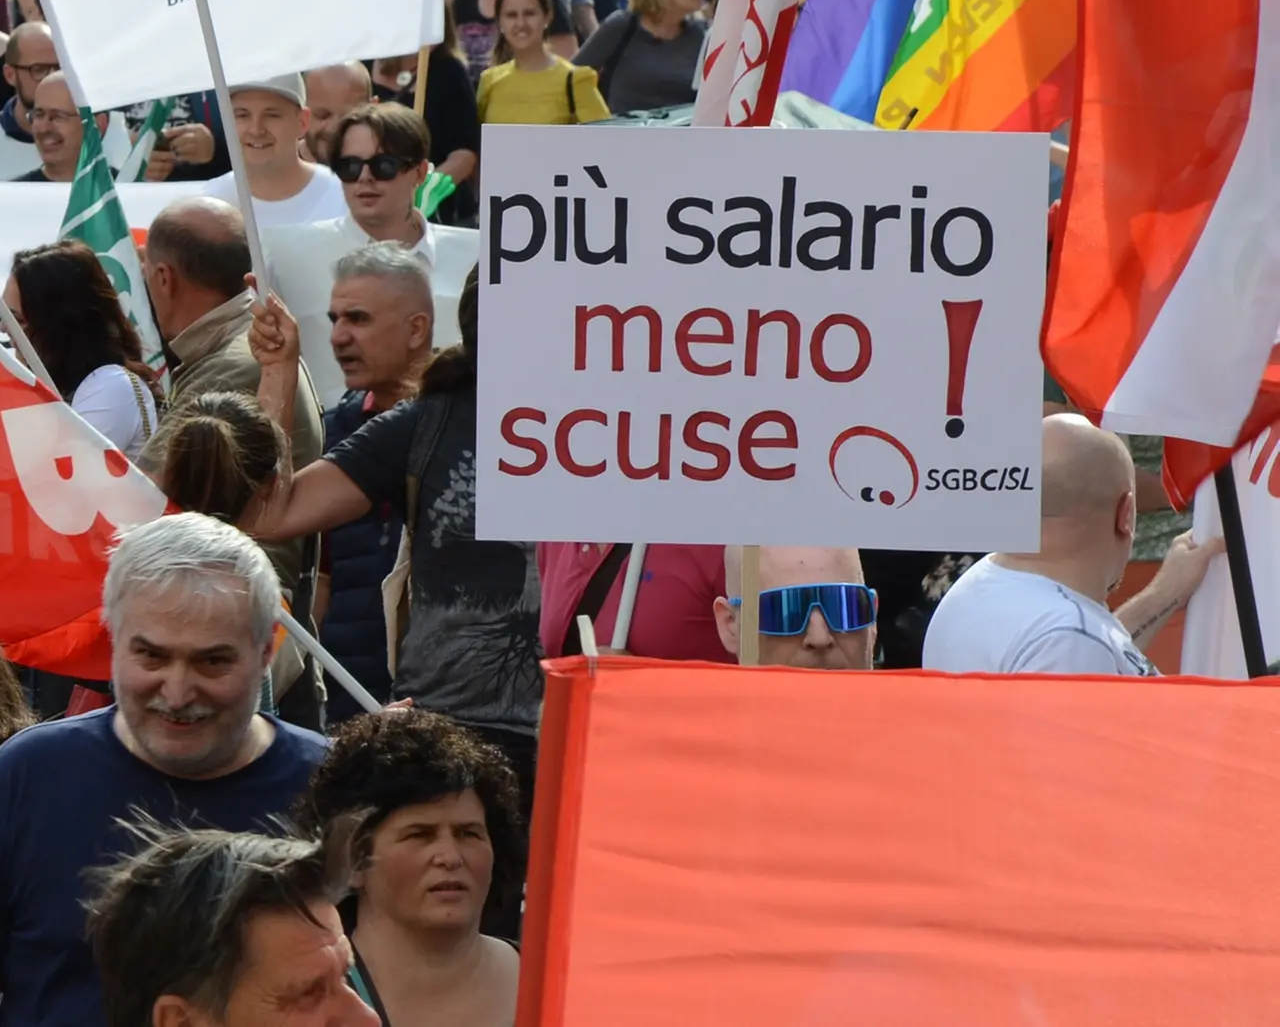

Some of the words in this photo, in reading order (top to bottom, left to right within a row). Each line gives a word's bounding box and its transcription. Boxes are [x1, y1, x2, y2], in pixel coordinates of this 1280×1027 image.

[489, 164, 628, 285] più
[665, 176, 994, 277] salario
[574, 303, 872, 383] meno
[498, 407, 799, 481] scuse
[925, 467, 1035, 492] SGBCISL
